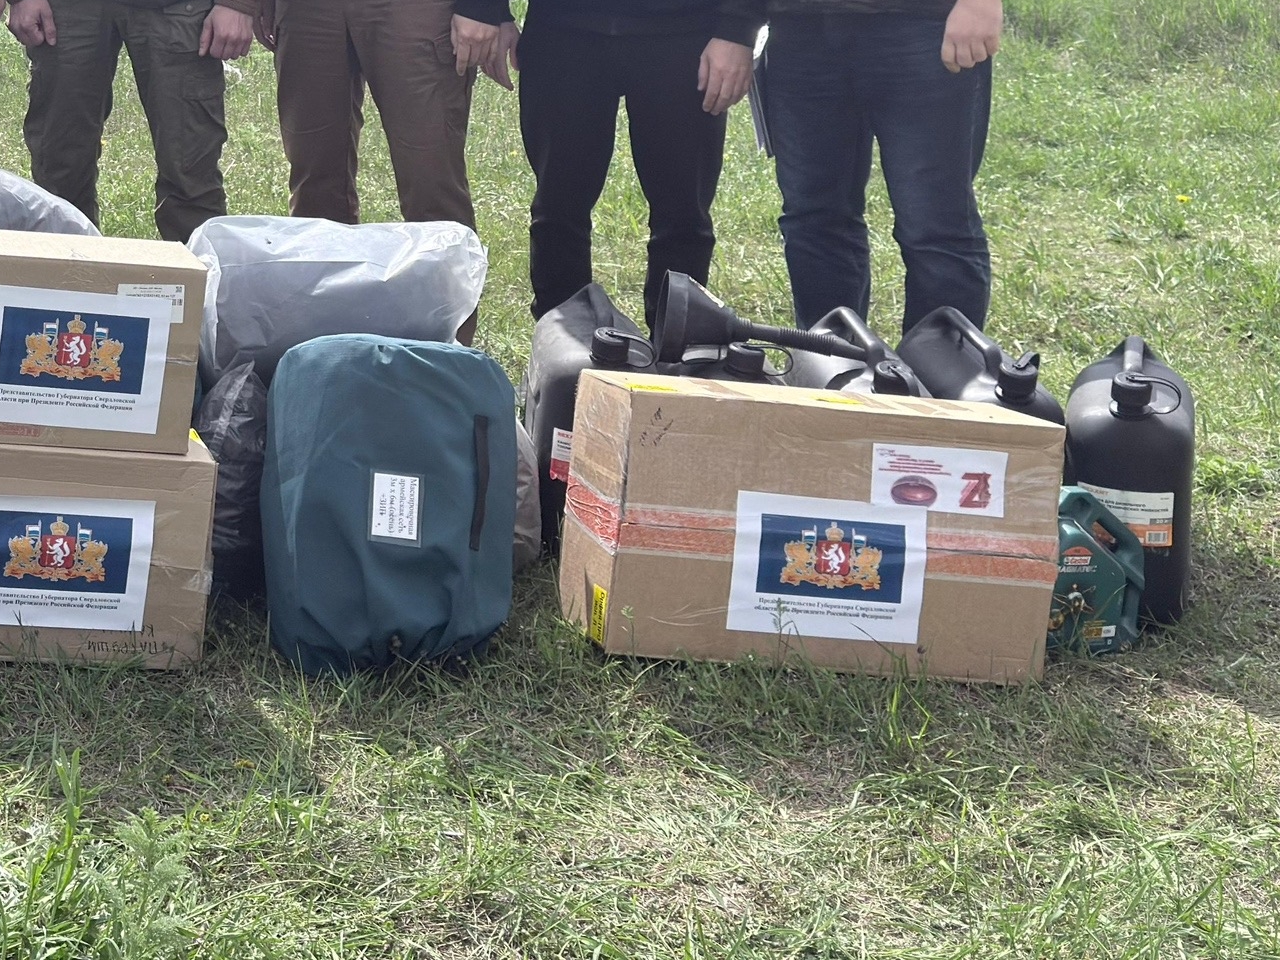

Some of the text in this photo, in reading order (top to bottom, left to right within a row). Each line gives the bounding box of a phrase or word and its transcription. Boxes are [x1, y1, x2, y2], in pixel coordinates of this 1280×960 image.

[31, 398, 64, 406] Президенте
[56, 393, 93, 401] Губернатора
[94, 396, 135, 404] Свердловской
[408, 479, 417, 535] Маскировочная
[387, 507, 396, 533] (осень)
[41, 594, 78, 602] Губернатора
[79, 596, 121, 604] Свердловской
[817, 601, 854, 610] Губернатора
